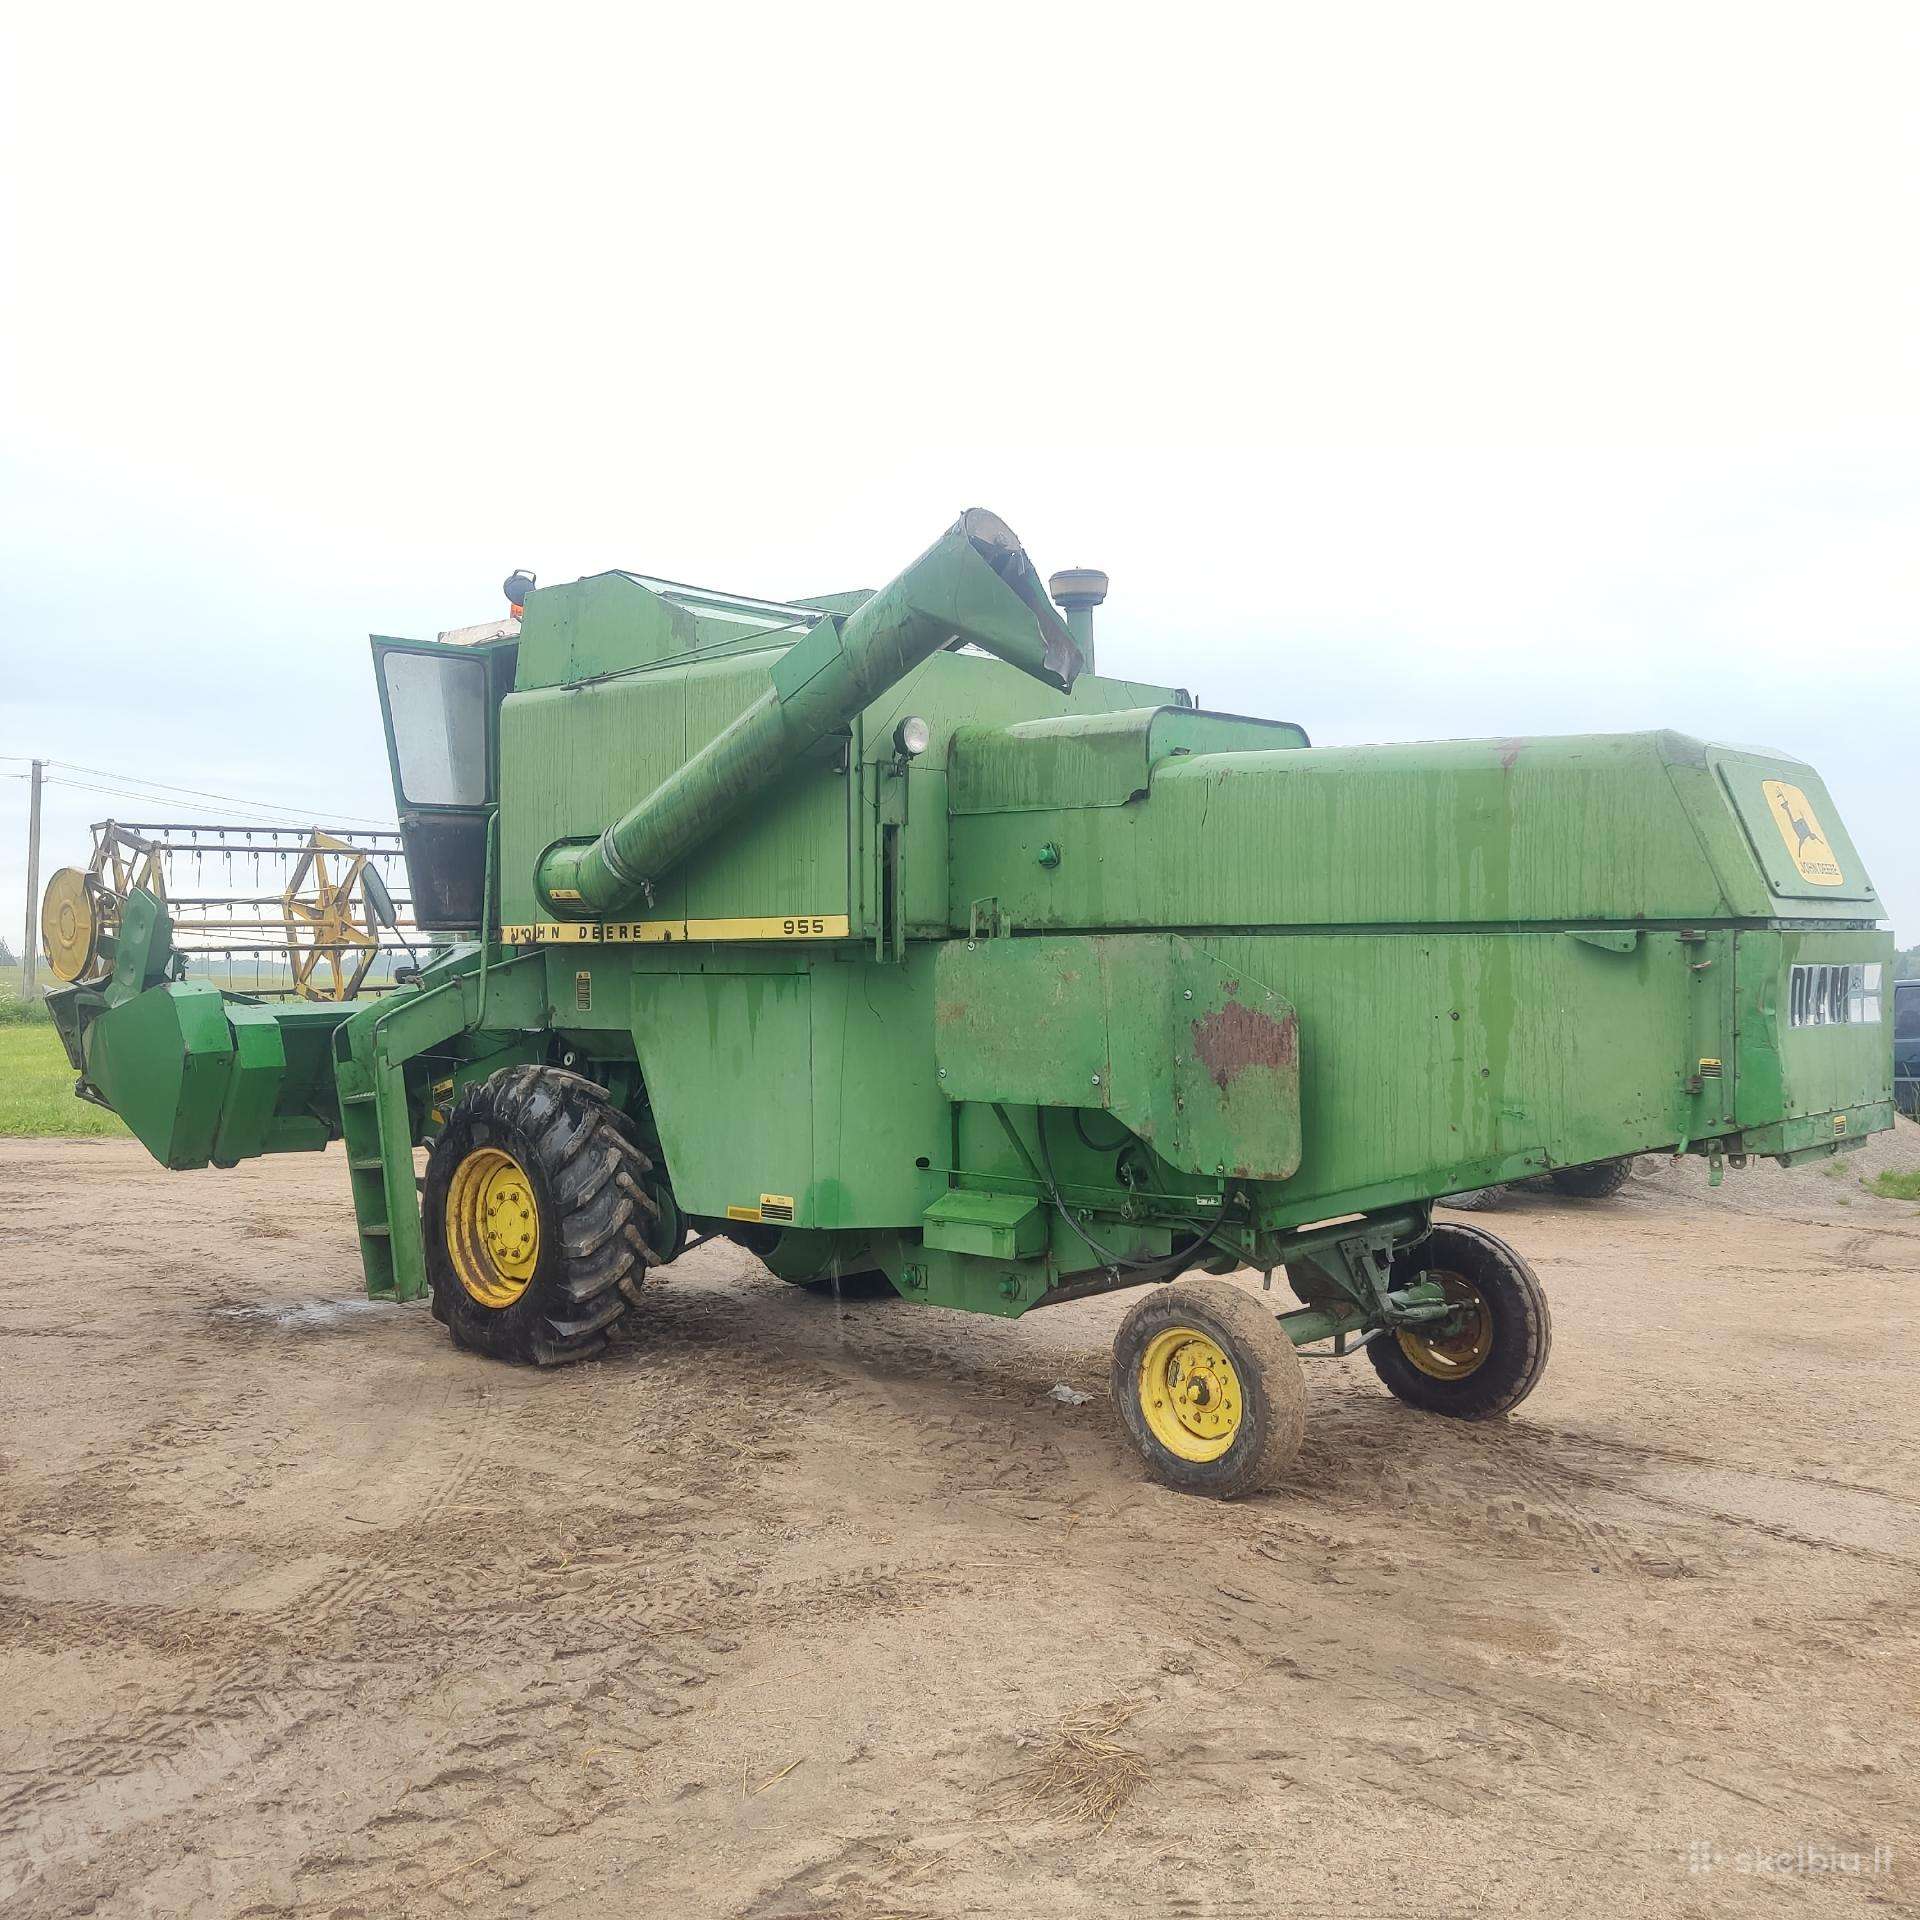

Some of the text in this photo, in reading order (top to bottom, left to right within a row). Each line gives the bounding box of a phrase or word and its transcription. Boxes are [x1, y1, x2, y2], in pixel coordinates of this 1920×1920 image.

[511, 924, 642, 942] JOHN DEERE
[783, 919, 824, 935] 955
